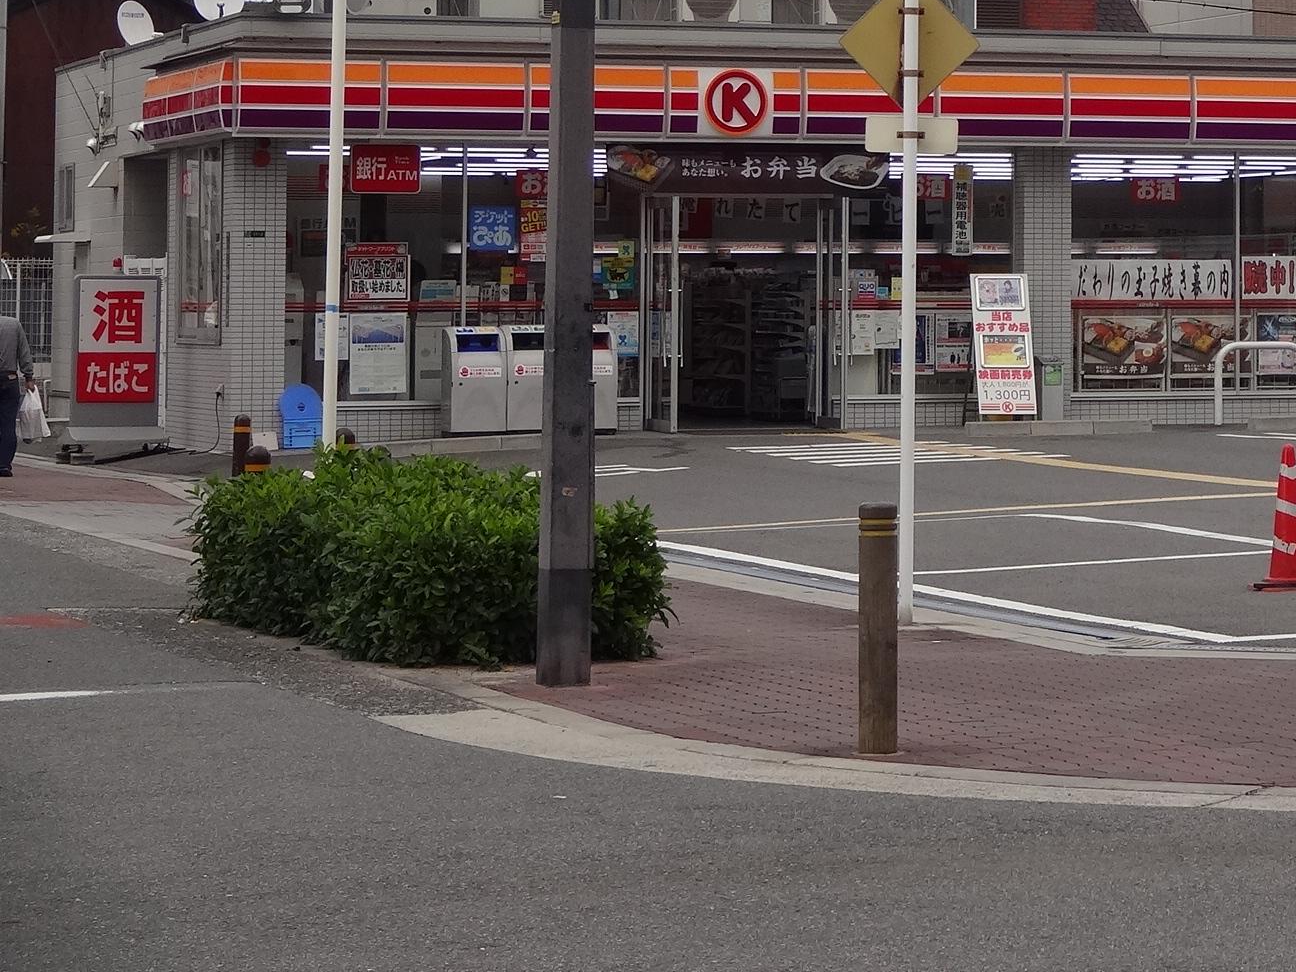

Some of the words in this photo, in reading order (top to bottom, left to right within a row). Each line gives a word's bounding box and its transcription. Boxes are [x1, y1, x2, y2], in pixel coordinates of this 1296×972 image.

[741, 156, 818, 179] お弁当
[1136, 178, 1176, 201] お酒
[474, 210, 513, 224] チケット
[955, 181, 968, 240] 補聴器用電池
[472, 224, 512, 246] ぴあ
[859, 283, 875, 291] QUO
[92, 290, 145, 343] 酒
[991, 311, 1013, 321] 当店
[975, 323, 1030, 333] おすすめ品
[978, 369, 1033, 380] 映画前売券
[1119, 365, 1148, 374] お弁当
[86, 362, 149, 393] たばこ
[984, 390, 1031, 401] 1,300円
